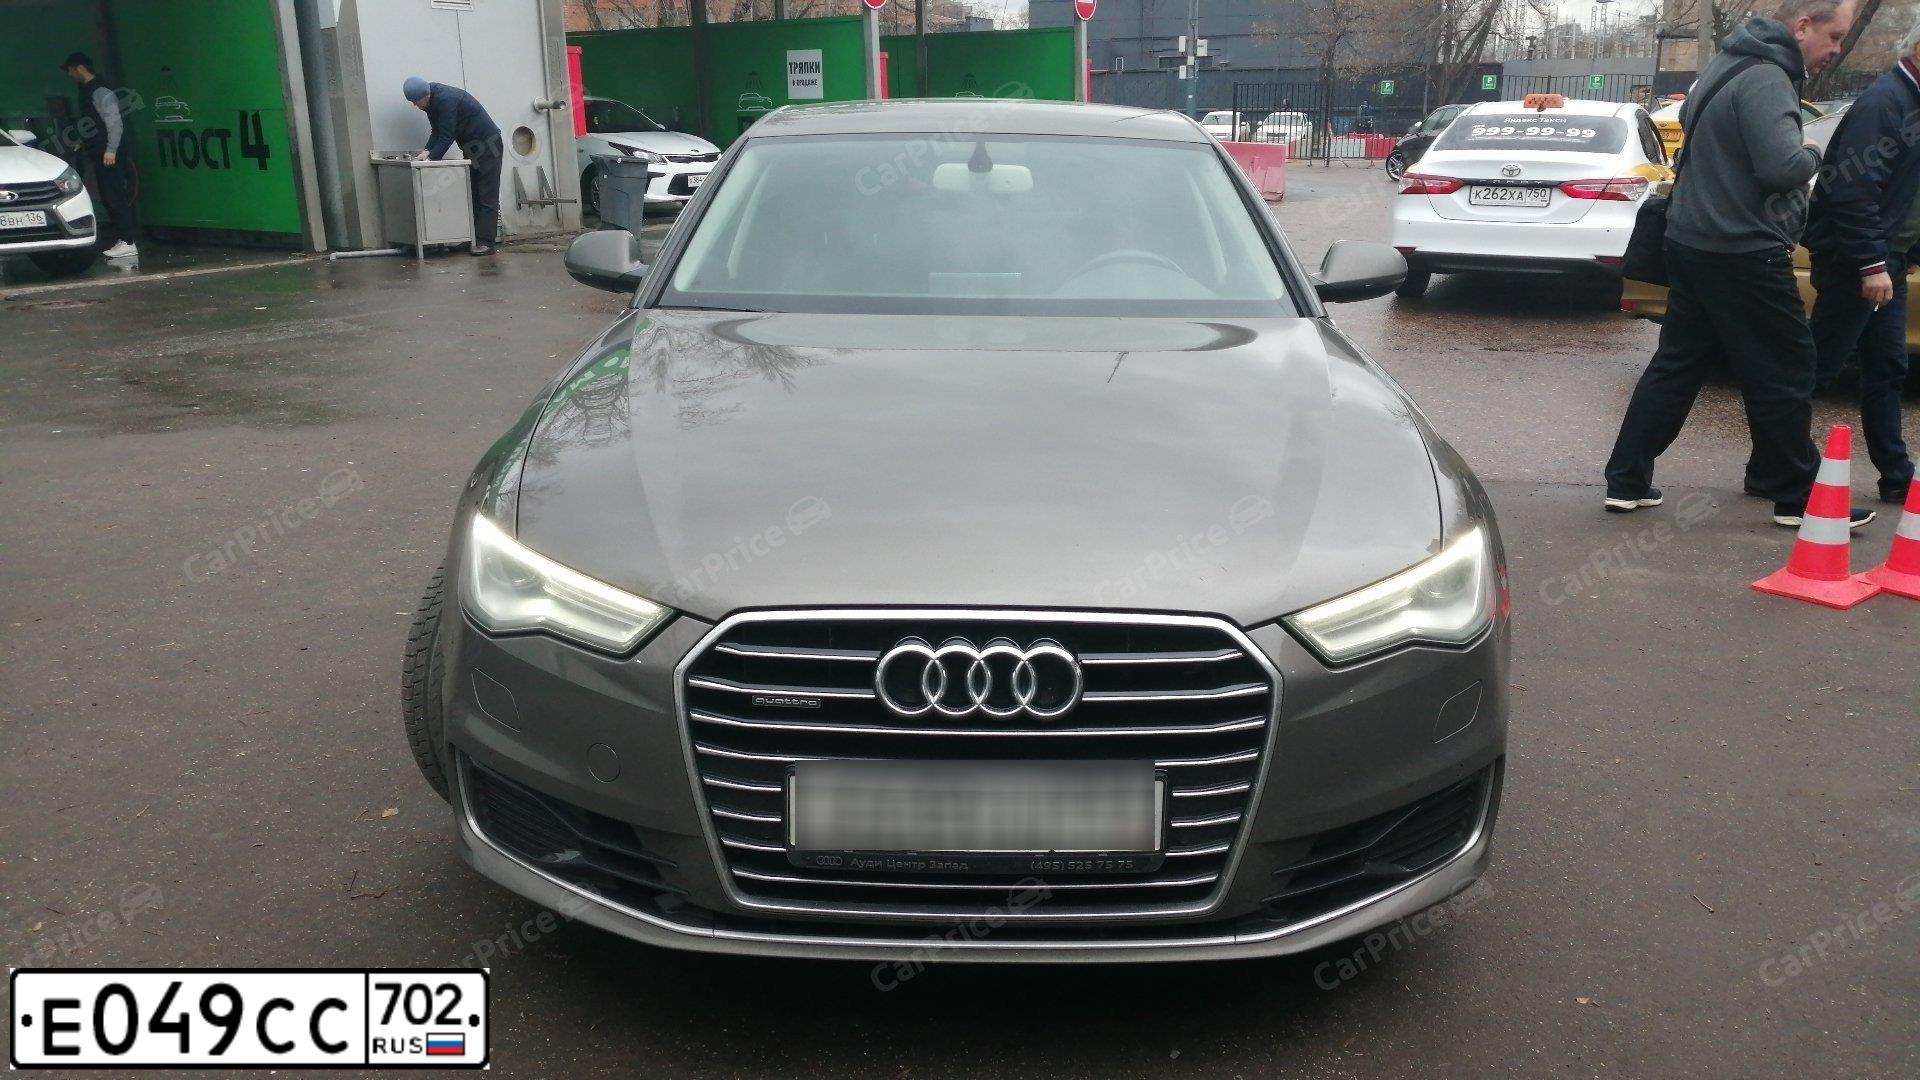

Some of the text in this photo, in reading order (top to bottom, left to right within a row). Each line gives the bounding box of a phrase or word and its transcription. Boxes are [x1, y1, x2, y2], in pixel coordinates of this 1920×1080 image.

[789, 61, 821, 75] ТРЯПКИ
[1471, 126, 1597, 138] 999-99-99
[156, 128, 232, 170] ПОСТ
[239, 109, 271, 171] 4
[755, 697, 818, 707] quattro
[850, 857, 883, 871] Ауди
[886, 858, 927, 872] Центр
[929, 859, 969, 872] Запад
[1030, 859, 1065, 871] (495)
